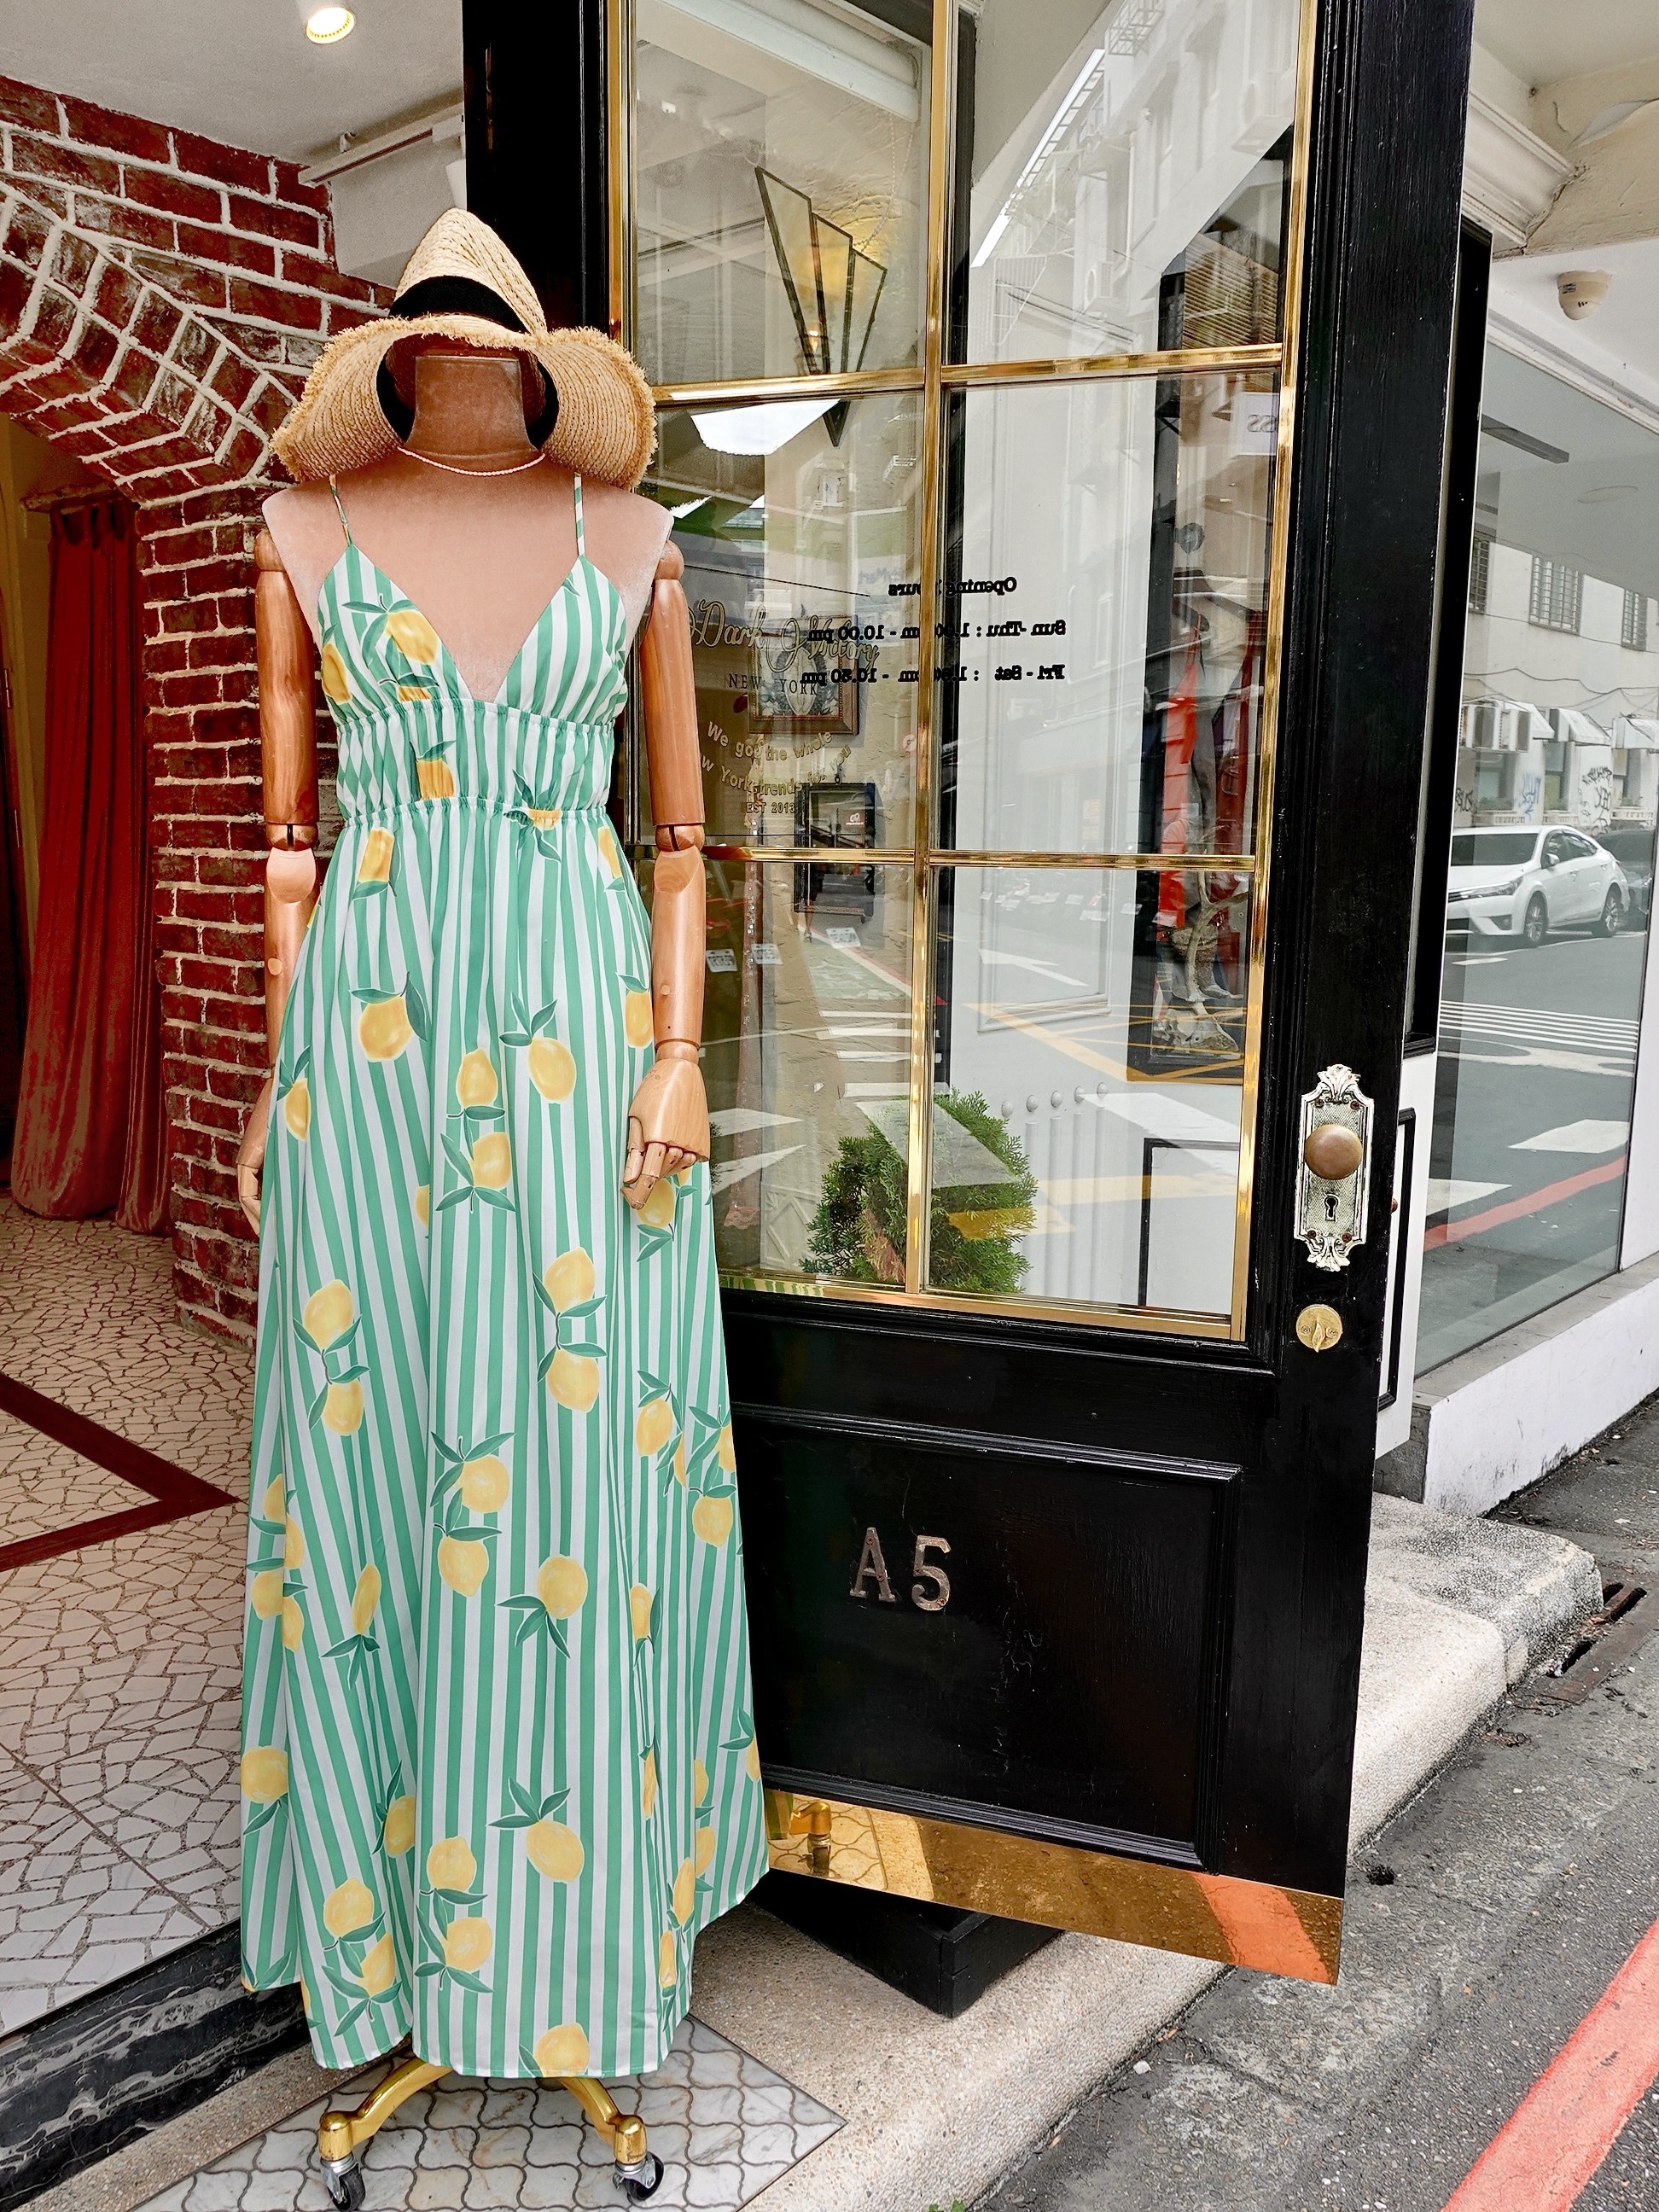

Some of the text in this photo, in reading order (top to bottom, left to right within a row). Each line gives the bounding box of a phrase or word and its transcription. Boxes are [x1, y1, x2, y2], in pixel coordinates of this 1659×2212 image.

[690, 599, 766, 649] Dark
[728, 673, 818, 696] NEW YORK
[707, 720, 729, 747] We
[765, 746, 788, 761] the
[792, 731, 833, 758] whole
[759, 777, 803, 796] trends
[807, 769, 826, 788] for
[829, 744, 852, 772] you
[746, 801, 795, 814] EST 2013
